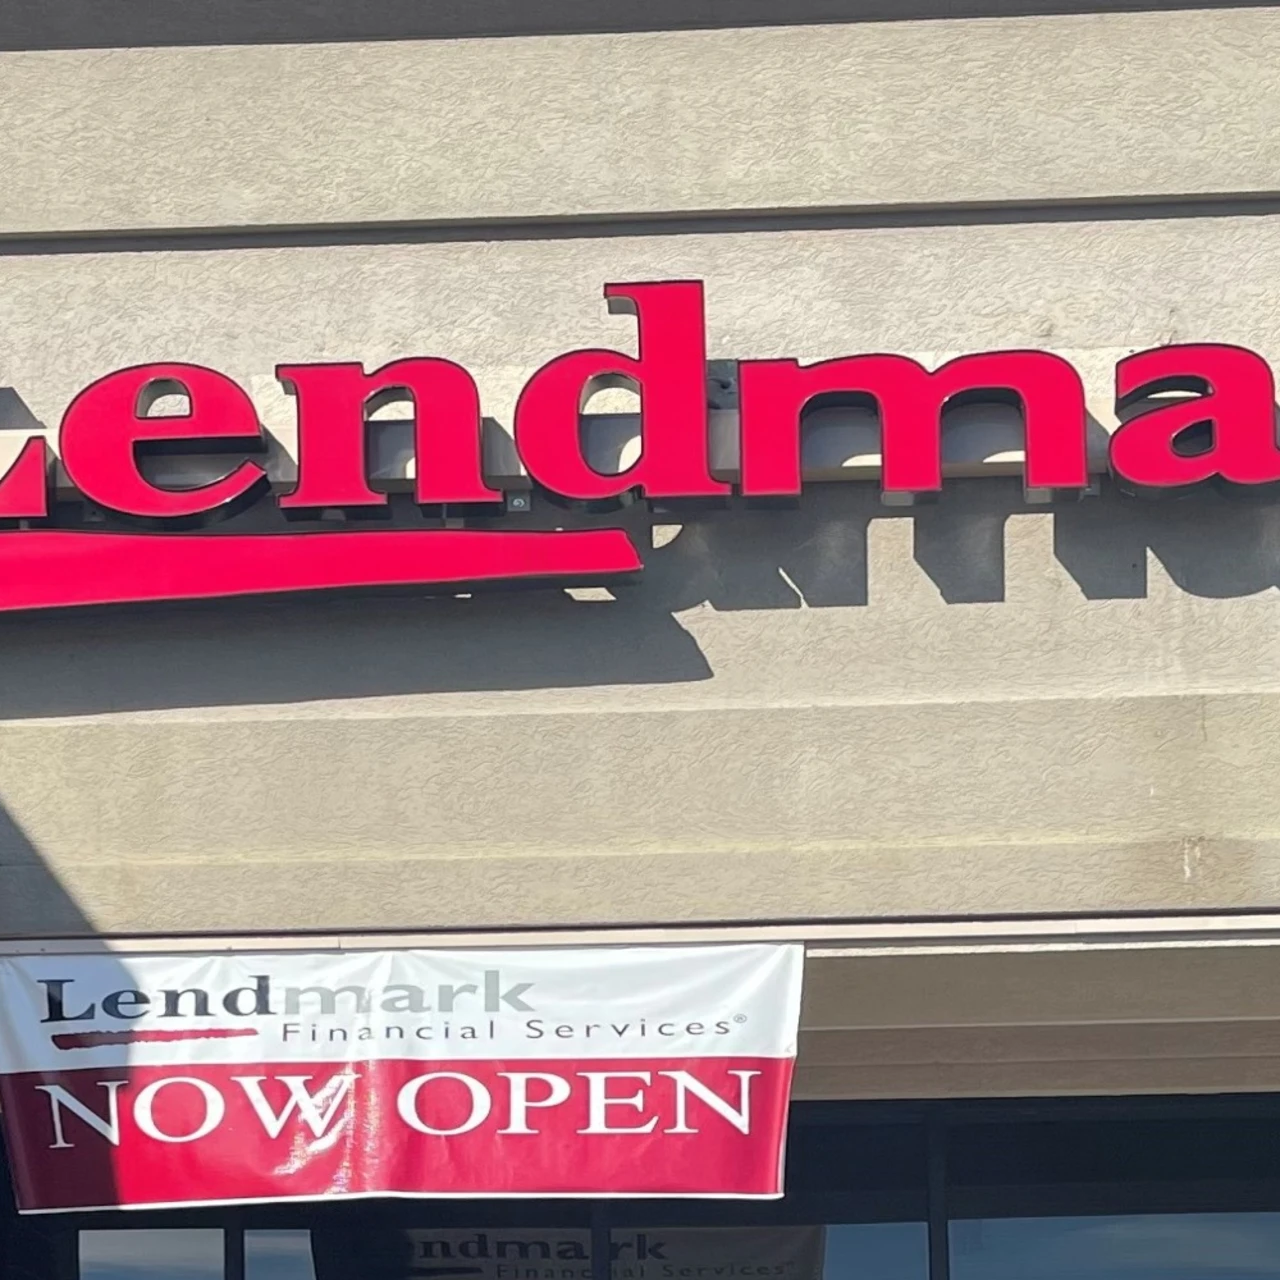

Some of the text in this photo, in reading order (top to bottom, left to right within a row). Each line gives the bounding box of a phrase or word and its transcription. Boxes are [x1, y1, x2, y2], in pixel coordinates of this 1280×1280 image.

[37, 969, 536, 1023] Lendmark
[282, 1020, 496, 1043] Financial
[34, 1069, 762, 1149] NOW OPEN
